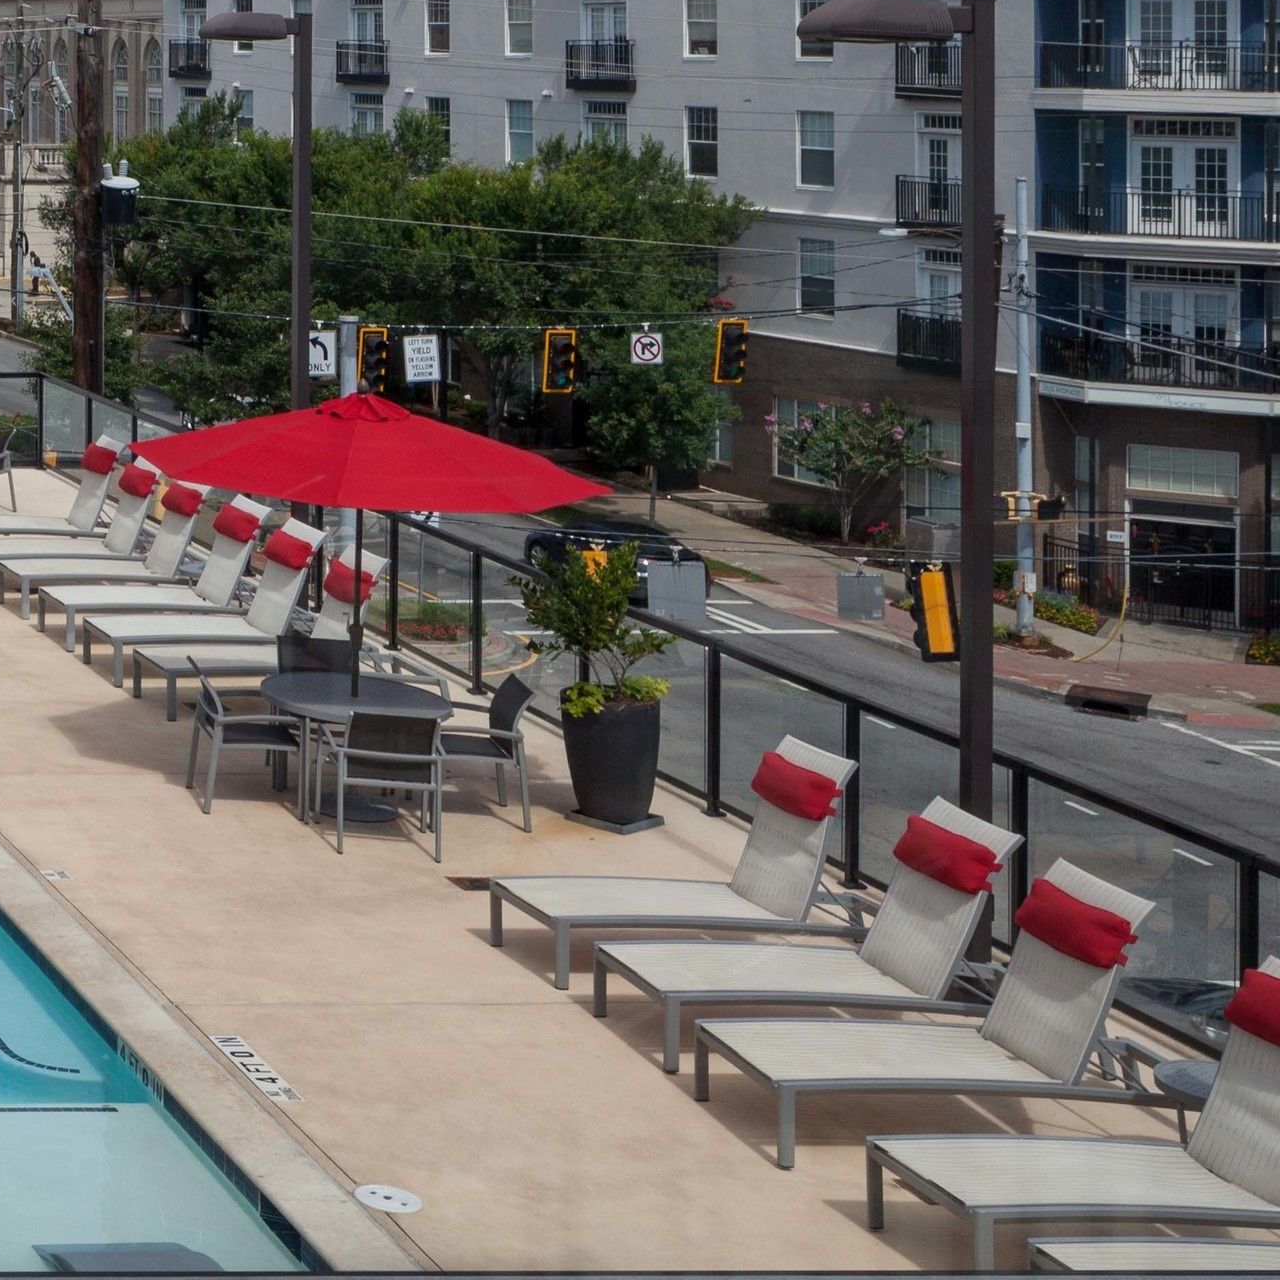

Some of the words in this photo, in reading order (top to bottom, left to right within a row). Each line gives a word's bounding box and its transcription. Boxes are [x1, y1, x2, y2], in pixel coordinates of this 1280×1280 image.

[411, 347, 431, 355] YIELD
[214, 1036, 244, 1047] IN
[239, 1061, 272, 1073] FT
[119, 1043, 126, 1062] 4
[129, 1051, 139, 1076] FT
[142, 1067, 149, 1088] 0
[152, 1076, 163, 1103] IN
[255, 1076, 280, 1085] 4
